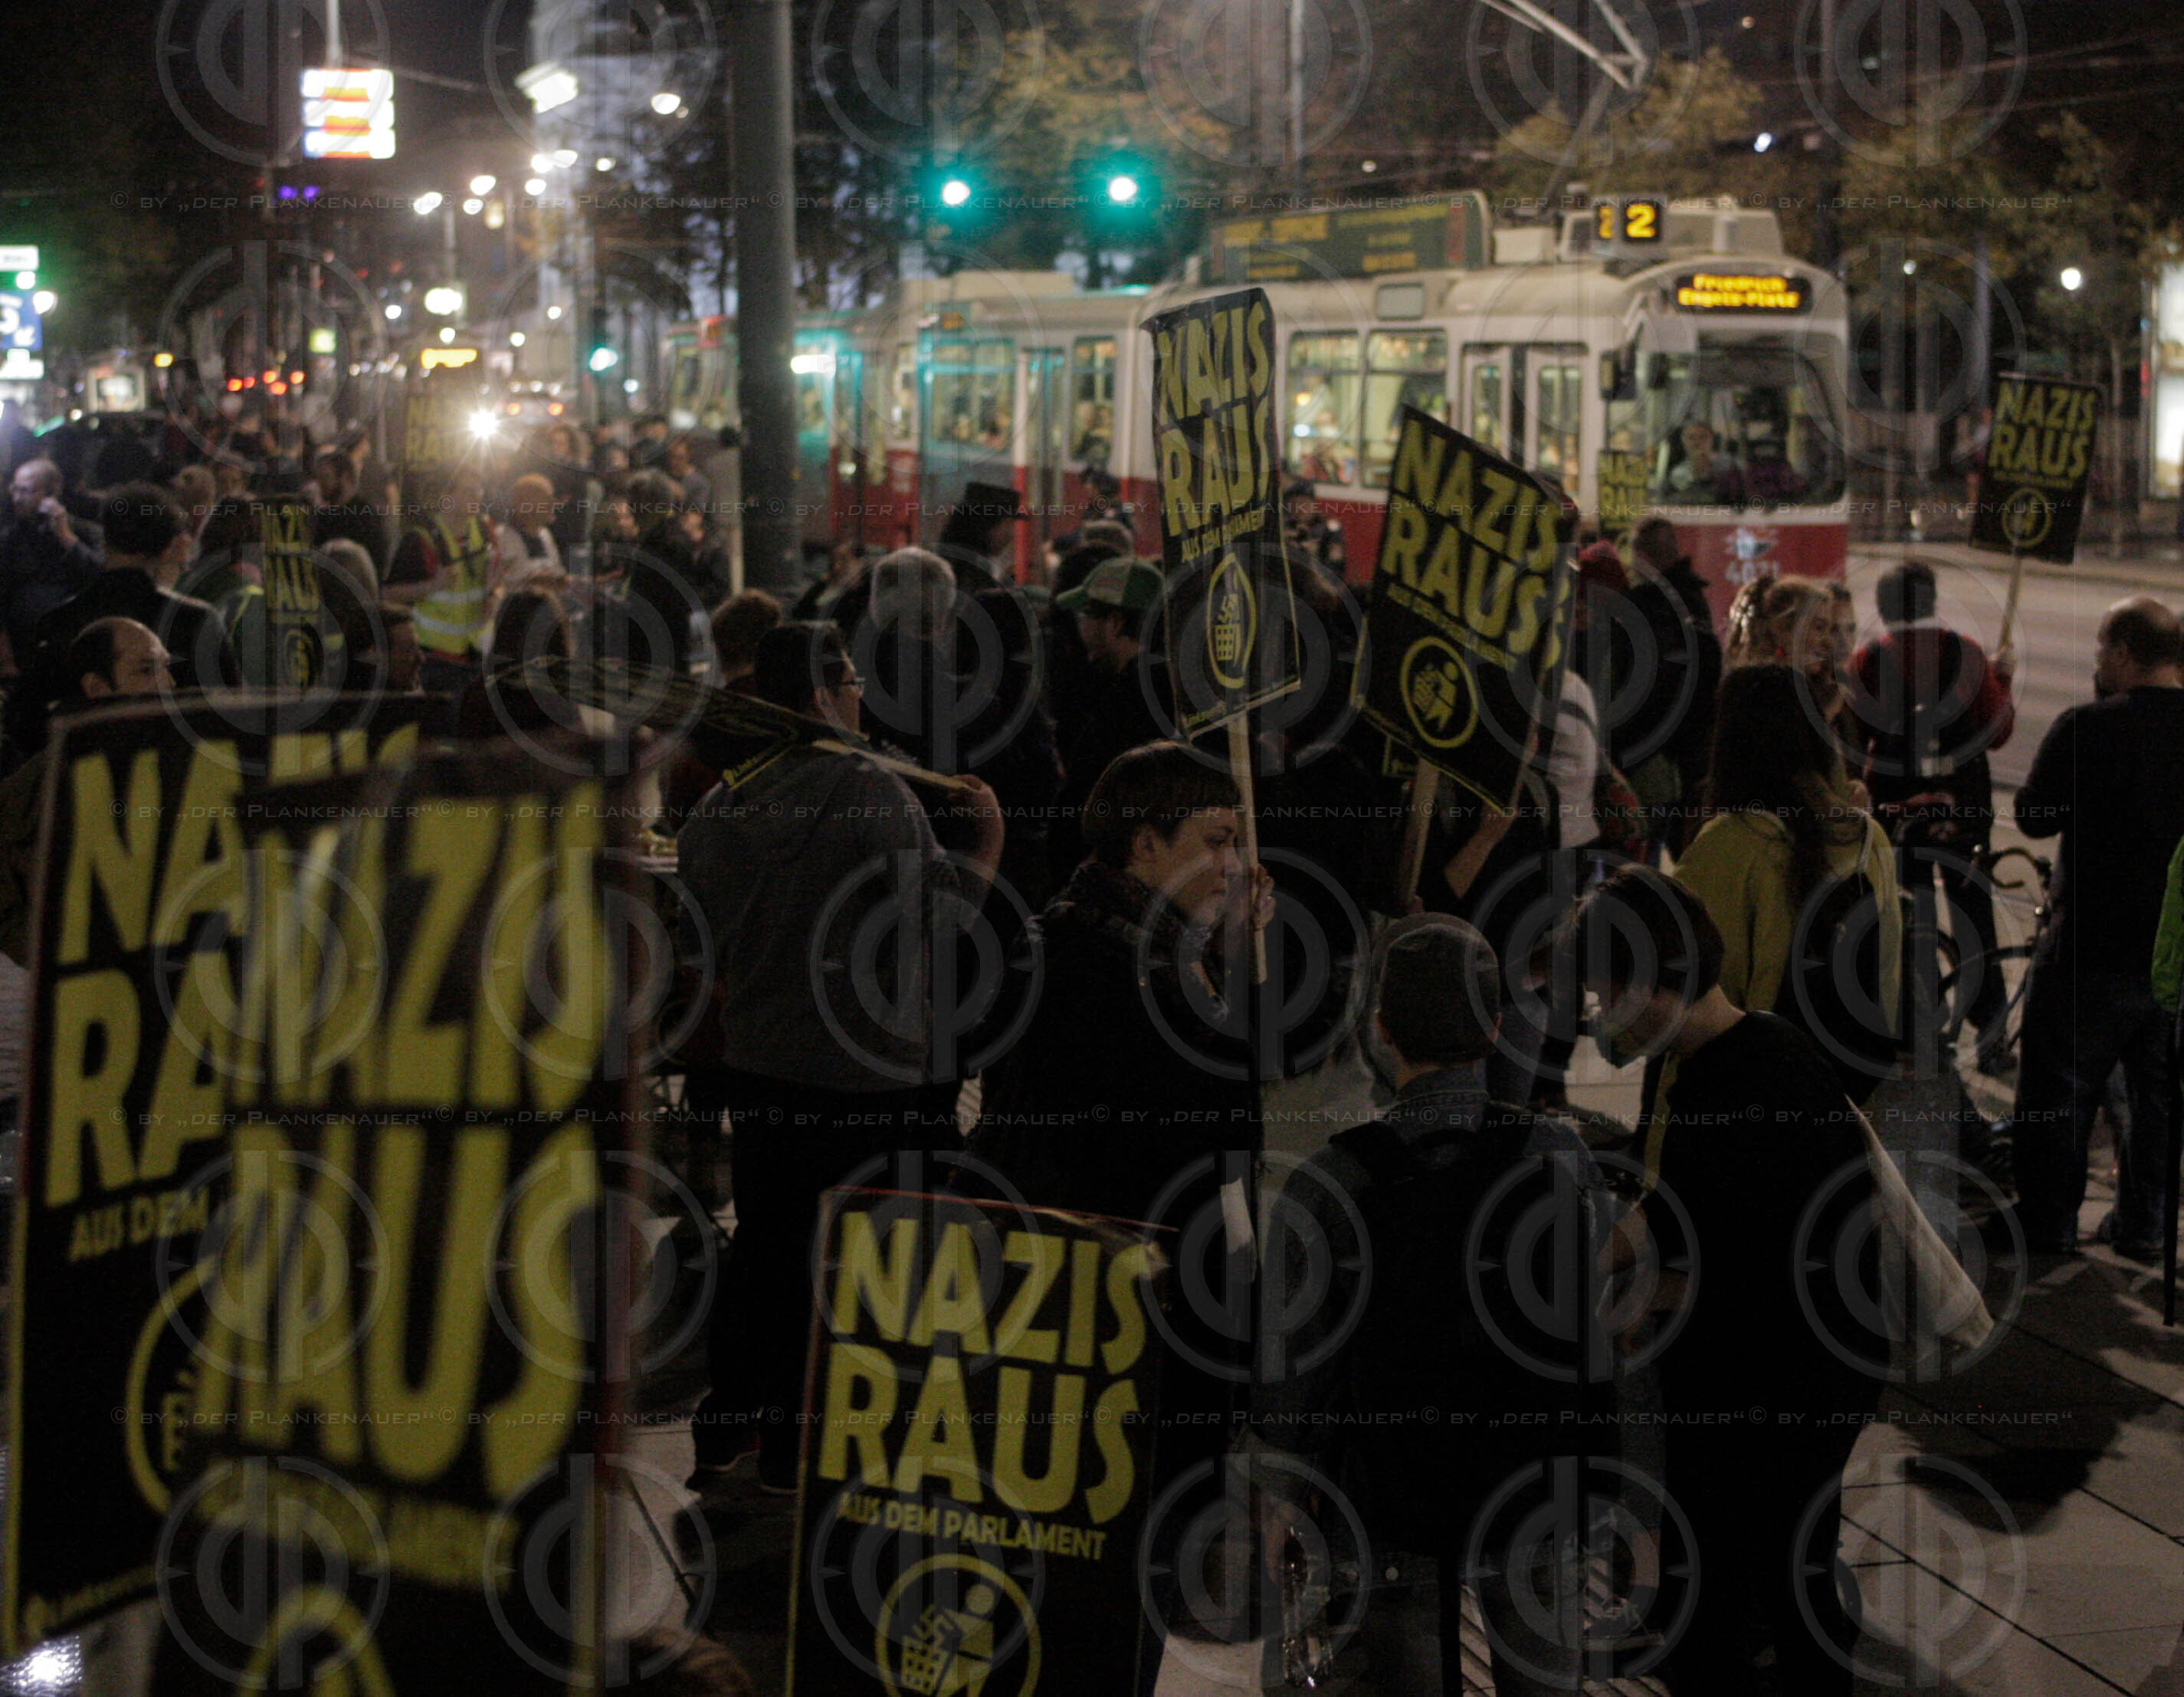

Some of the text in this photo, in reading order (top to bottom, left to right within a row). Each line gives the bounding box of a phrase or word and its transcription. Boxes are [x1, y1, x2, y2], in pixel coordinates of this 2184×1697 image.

[1626, 202, 1656, 238] 2
[1159, 300, 1268, 426] NAZIS
[1995, 380, 2097, 432] NAZIS
[1161, 395, 1269, 537] RAUS
[1395, 419, 1562, 573] NAZIS
[1989, 422, 2090, 478] RAUS
[1381, 494, 1547, 655] RAUS
[44, 953, 239, 1208] RA
[193, 1122, 602, 1501] RAUS
[831, 1211, 1162, 1375] NAZIS
[818, 1342, 1141, 1525] RAUS
[837, 1491, 1107, 1561] AUS DEM PARLAMENT
